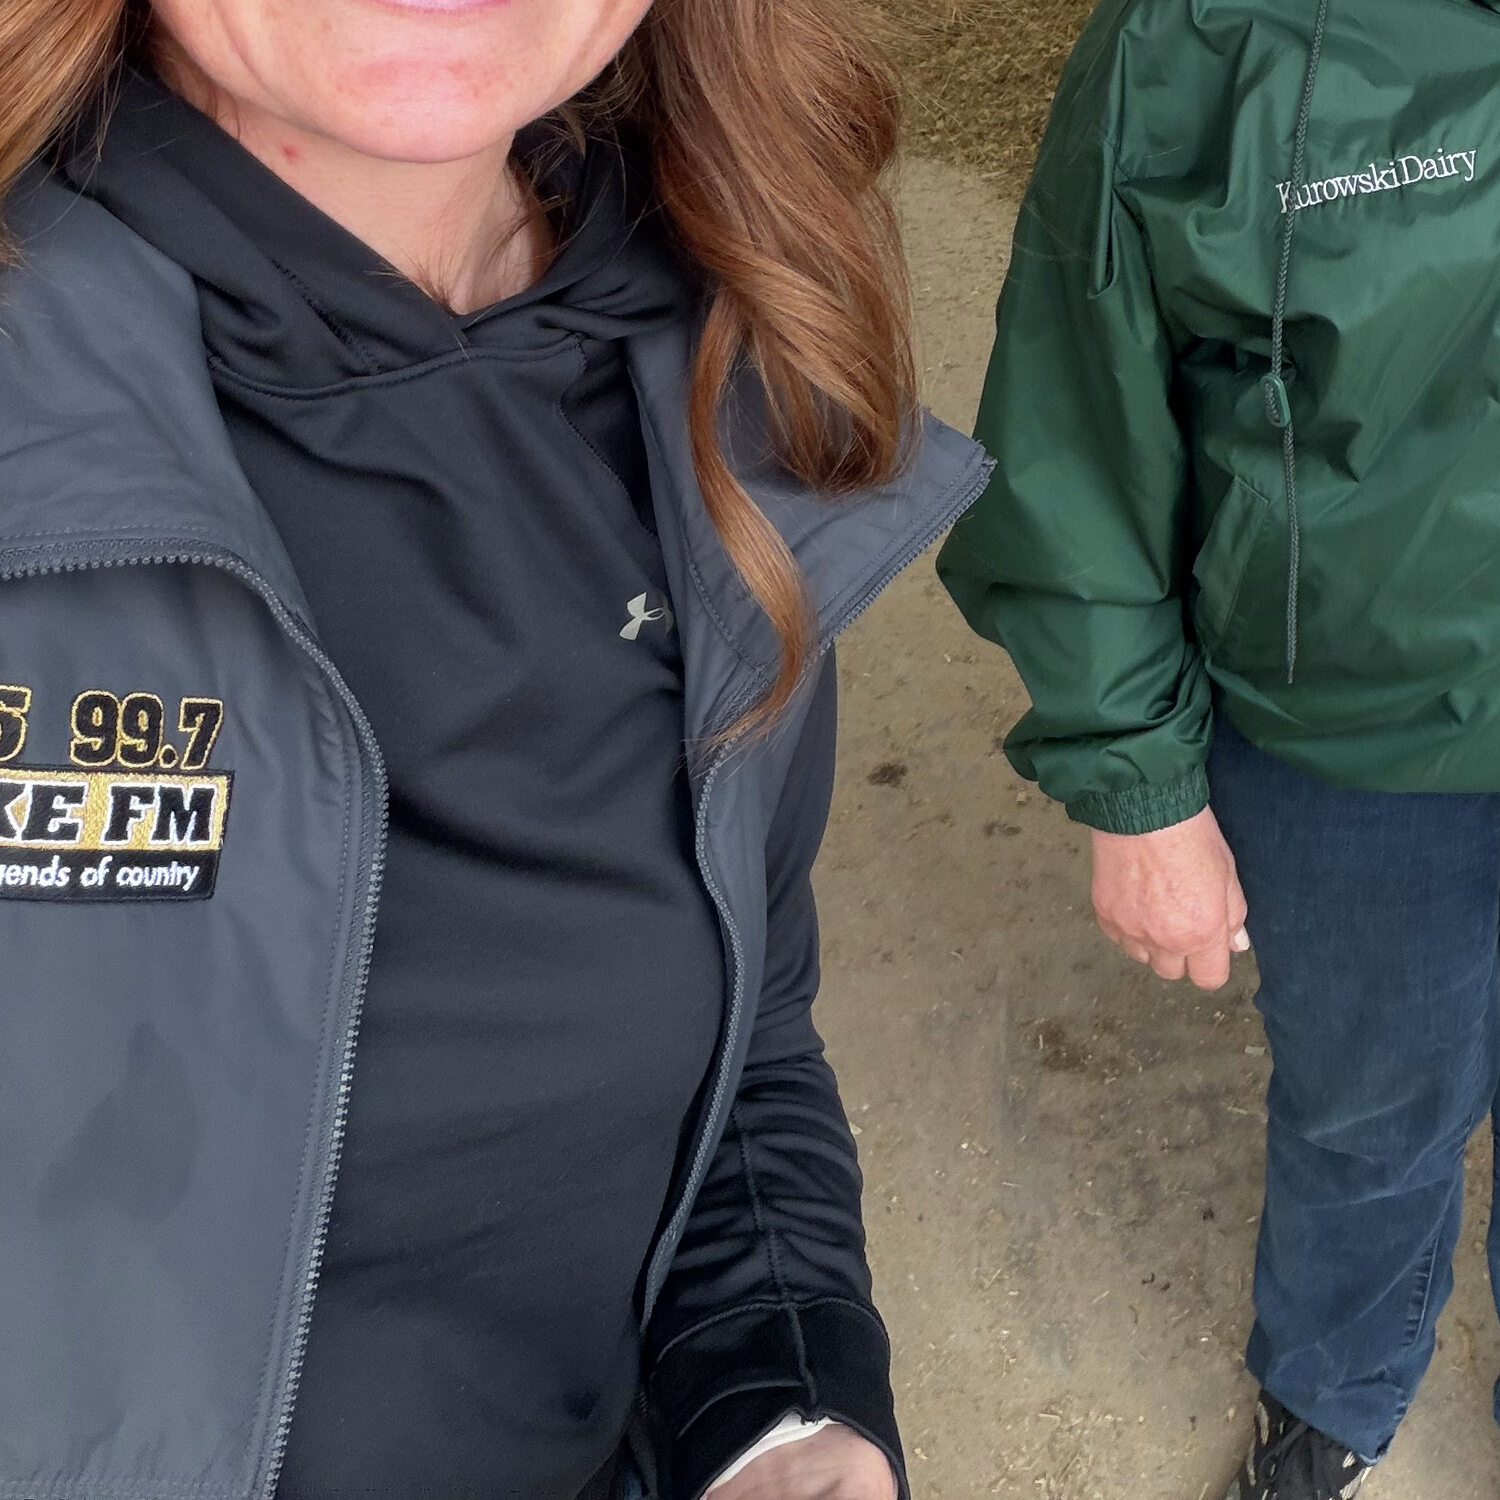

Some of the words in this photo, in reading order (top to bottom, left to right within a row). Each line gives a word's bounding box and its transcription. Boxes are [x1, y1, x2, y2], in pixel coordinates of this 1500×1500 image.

[69, 690, 224, 770] 99.7
[100, 782, 219, 846] FM
[80, 855, 114, 887] of
[116, 861, 200, 891] country
